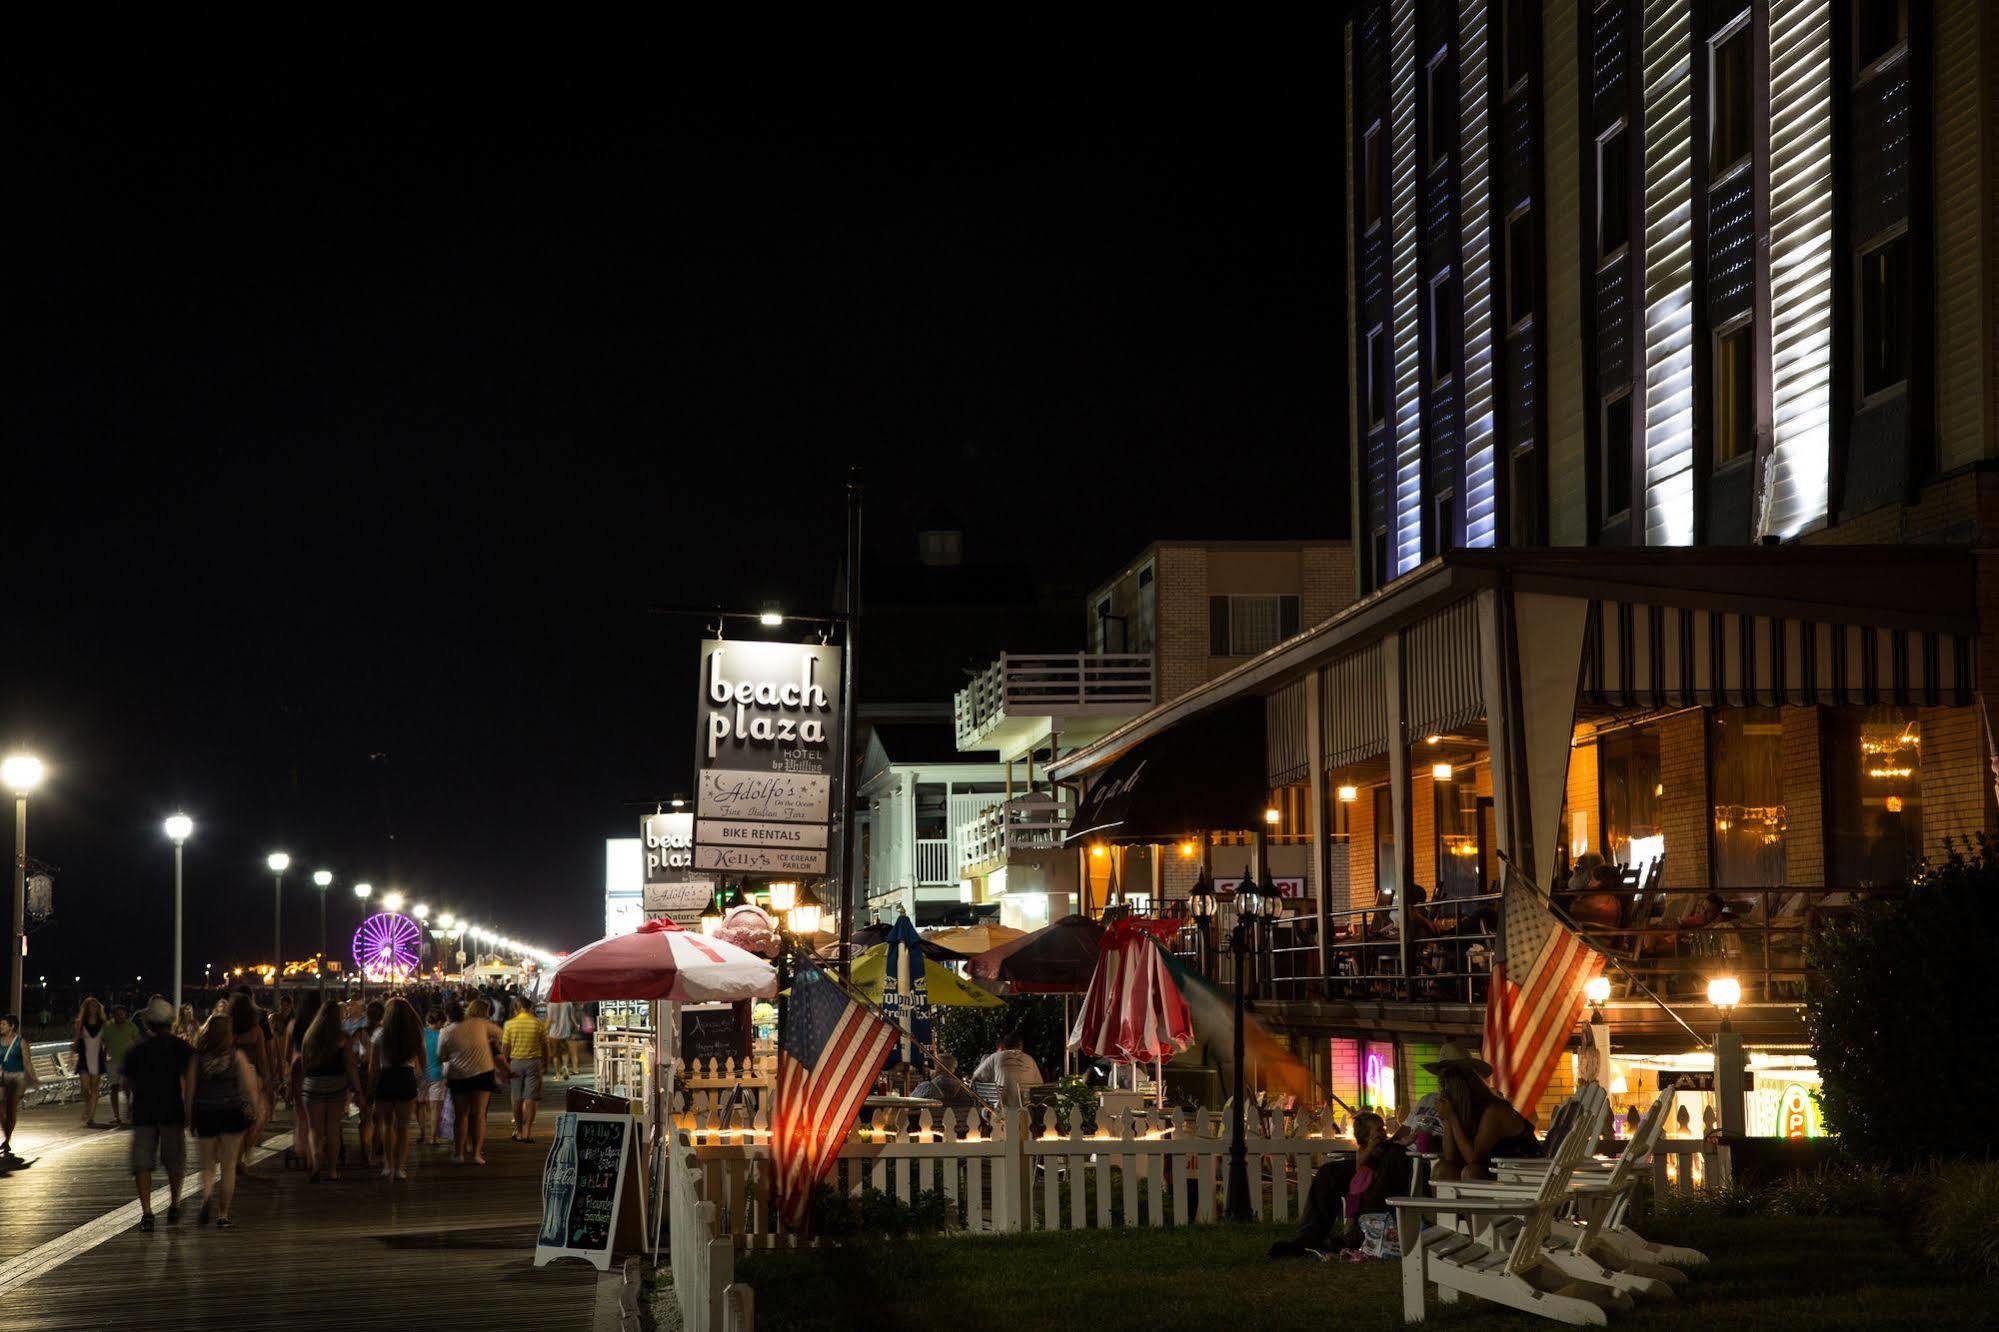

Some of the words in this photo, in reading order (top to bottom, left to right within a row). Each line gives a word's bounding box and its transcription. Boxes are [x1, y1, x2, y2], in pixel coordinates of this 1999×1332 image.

[710, 648, 827, 707] beach
[708, 702, 825, 758] plaza
[784, 749, 823, 760] HOTEL
[772, 760, 783, 771] by
[714, 778, 795, 806] Adolfo's
[646, 819, 692, 849] beac
[723, 828, 748, 839] BIKE
[751, 829, 801, 841] RENTALS
[647, 848, 692, 878] plaz
[703, 847, 771, 868] Kelly's
[782, 862, 811, 870] PARLOR
[791, 854, 817, 863] CREAM
